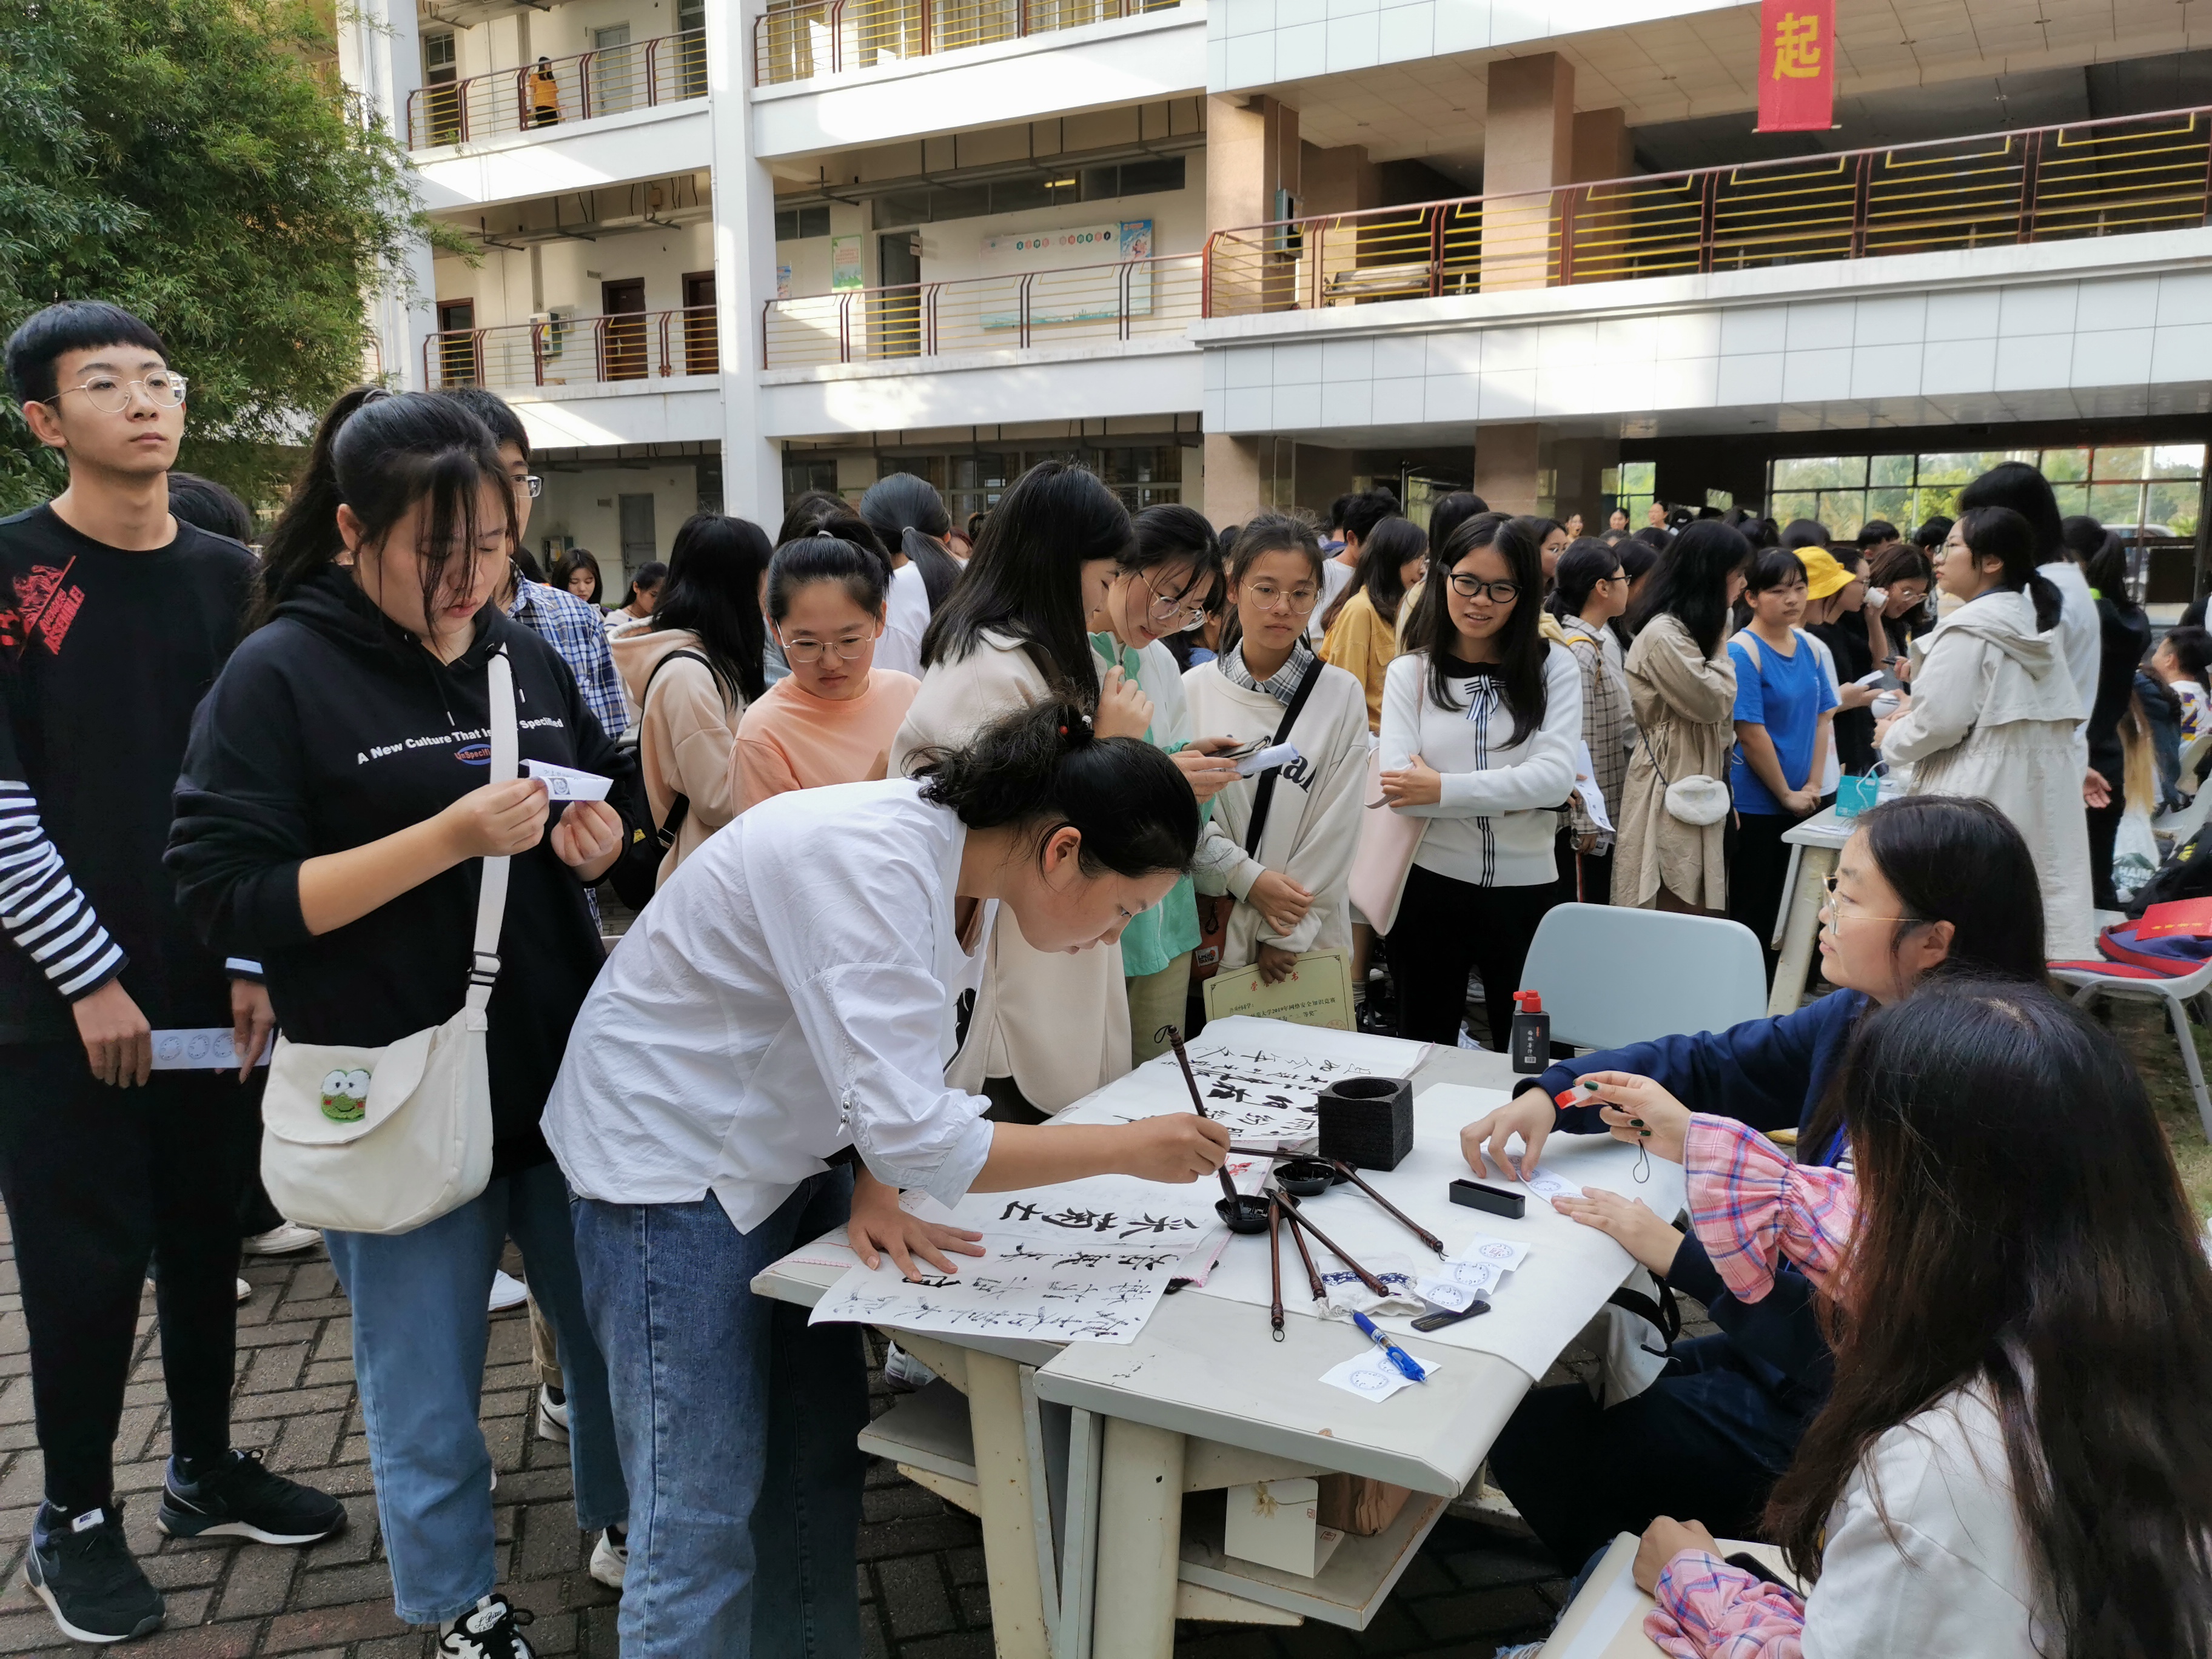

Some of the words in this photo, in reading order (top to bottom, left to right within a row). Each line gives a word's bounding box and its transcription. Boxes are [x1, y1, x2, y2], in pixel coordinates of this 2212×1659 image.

[1772, 12, 1821, 81] 起
[357, 752, 369, 765] A
[370, 742, 403, 759] New
[405, 734, 452, 749] Culture
[451, 728, 480, 742] That
